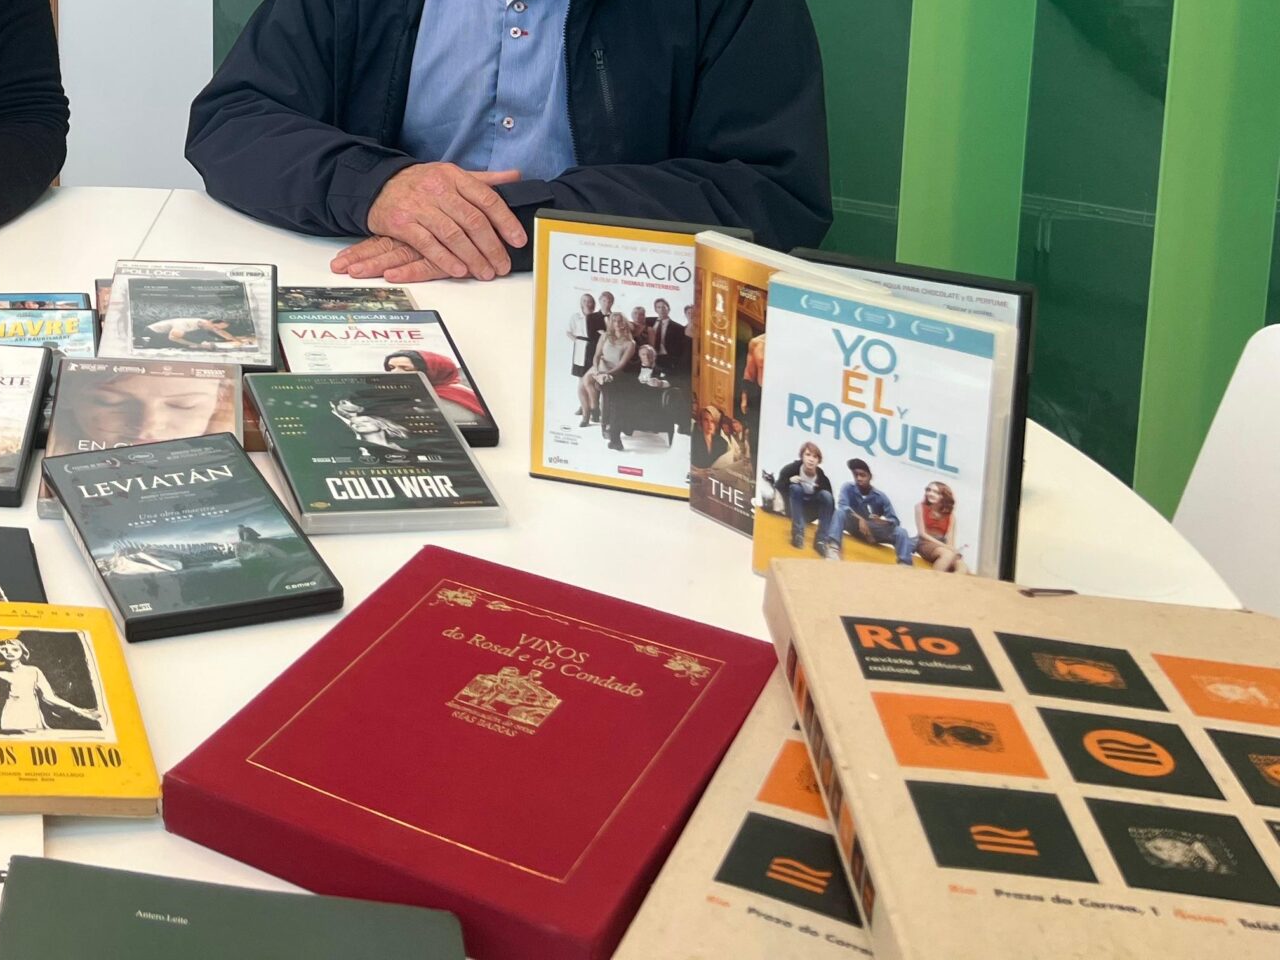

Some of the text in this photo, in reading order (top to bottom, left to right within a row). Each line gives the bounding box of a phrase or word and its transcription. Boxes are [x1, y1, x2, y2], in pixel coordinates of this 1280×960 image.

[121, 268, 181, 277] POLLOCK
[562, 253, 692, 283] CELEBRACIÓ
[921, 288, 960, 301] CHOCOLATE
[291, 329, 424, 340] VIAJANTE
[842, 365, 894, 416] ÉL
[77, 440, 106, 451] EN
[787, 393, 959, 474] RAQUEL
[77, 465, 234, 499] LEVIATÁN
[326, 475, 460, 500] COLD WAR
[708, 477, 744, 509] THE
[518, 632, 590, 665] VIÑOS
[854, 624, 961, 656] Río
[442, 626, 644, 698] do Rosal e do Condado
[918, 661, 974, 672] cultural
[30, 746, 58, 766] DO
[71, 744, 122, 768] MIÑO
[135, 909, 189, 925] Antero Leite
